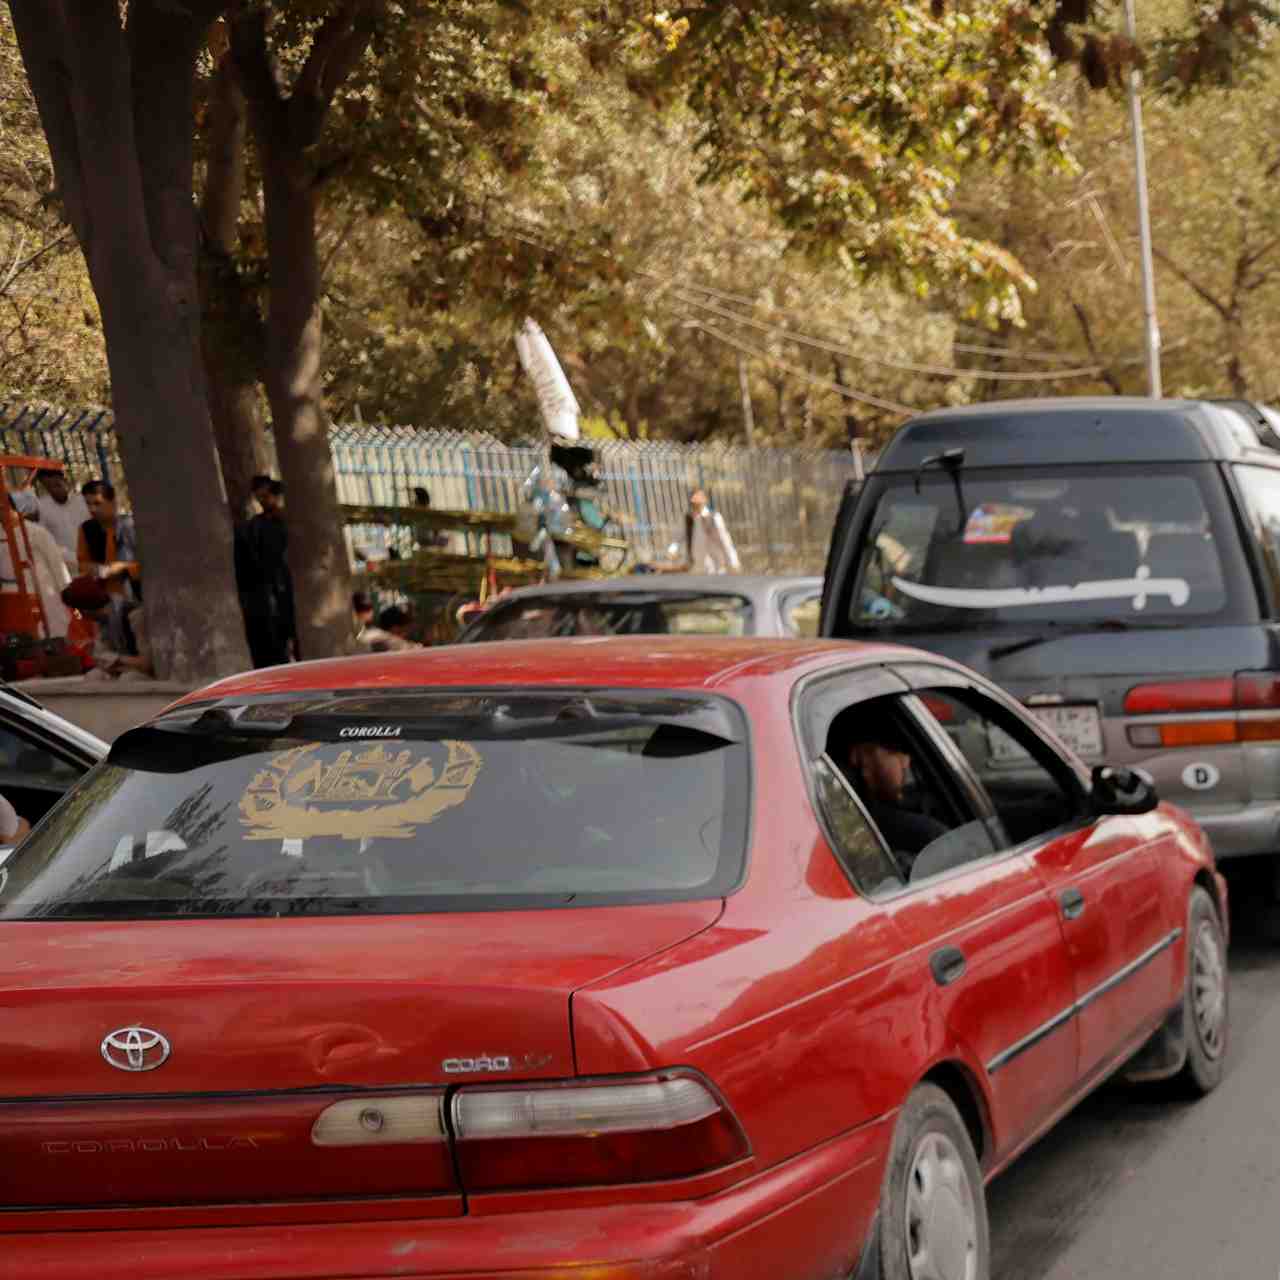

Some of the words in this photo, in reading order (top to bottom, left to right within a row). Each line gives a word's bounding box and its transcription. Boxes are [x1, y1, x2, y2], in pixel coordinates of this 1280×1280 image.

[339, 726, 402, 738] COROLLA
[1195, 767, 1208, 785] D
[41, 1132, 260, 1153] COROLLA
